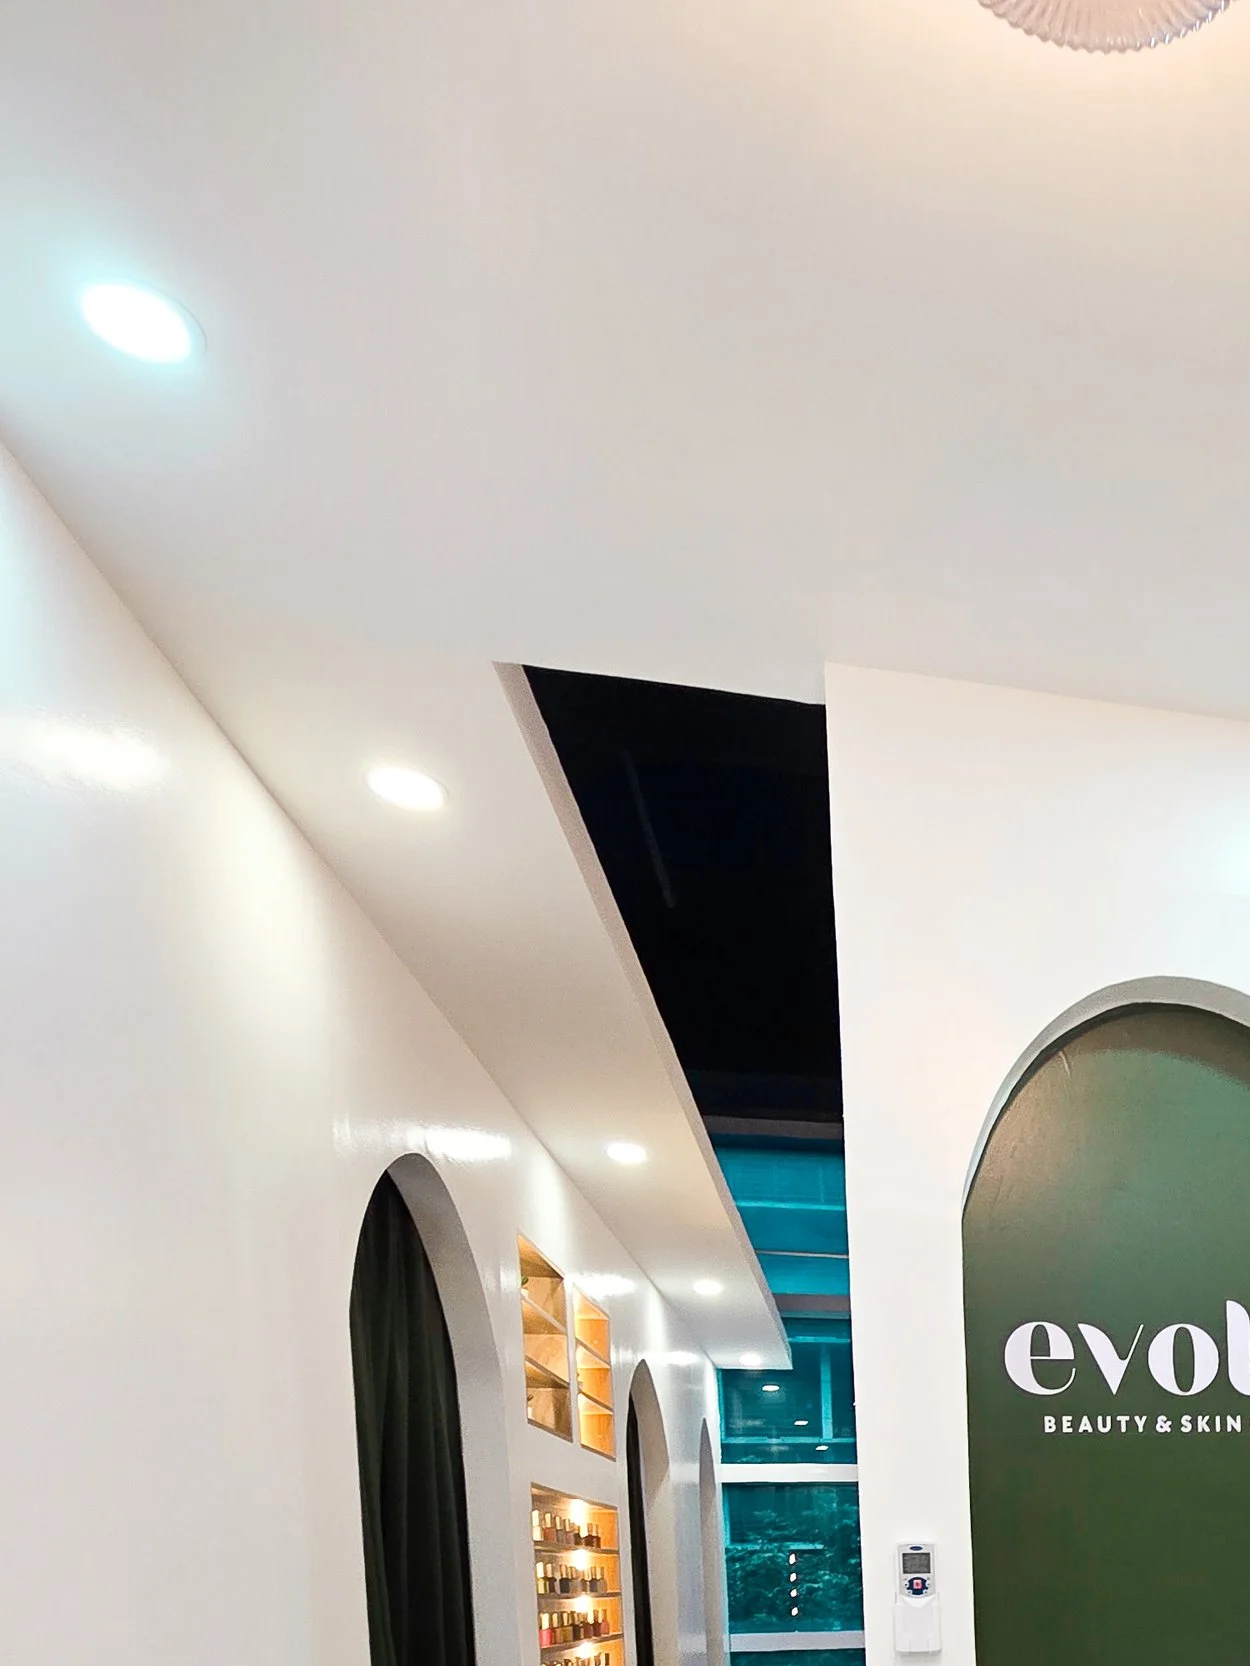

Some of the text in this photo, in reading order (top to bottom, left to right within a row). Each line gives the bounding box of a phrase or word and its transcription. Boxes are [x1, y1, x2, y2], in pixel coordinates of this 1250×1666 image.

[1043, 1415, 1148, 1433] BEAUTY
[1155, 1415, 1172, 1433] &
[1180, 1414, 1242, 1433] SKIN
